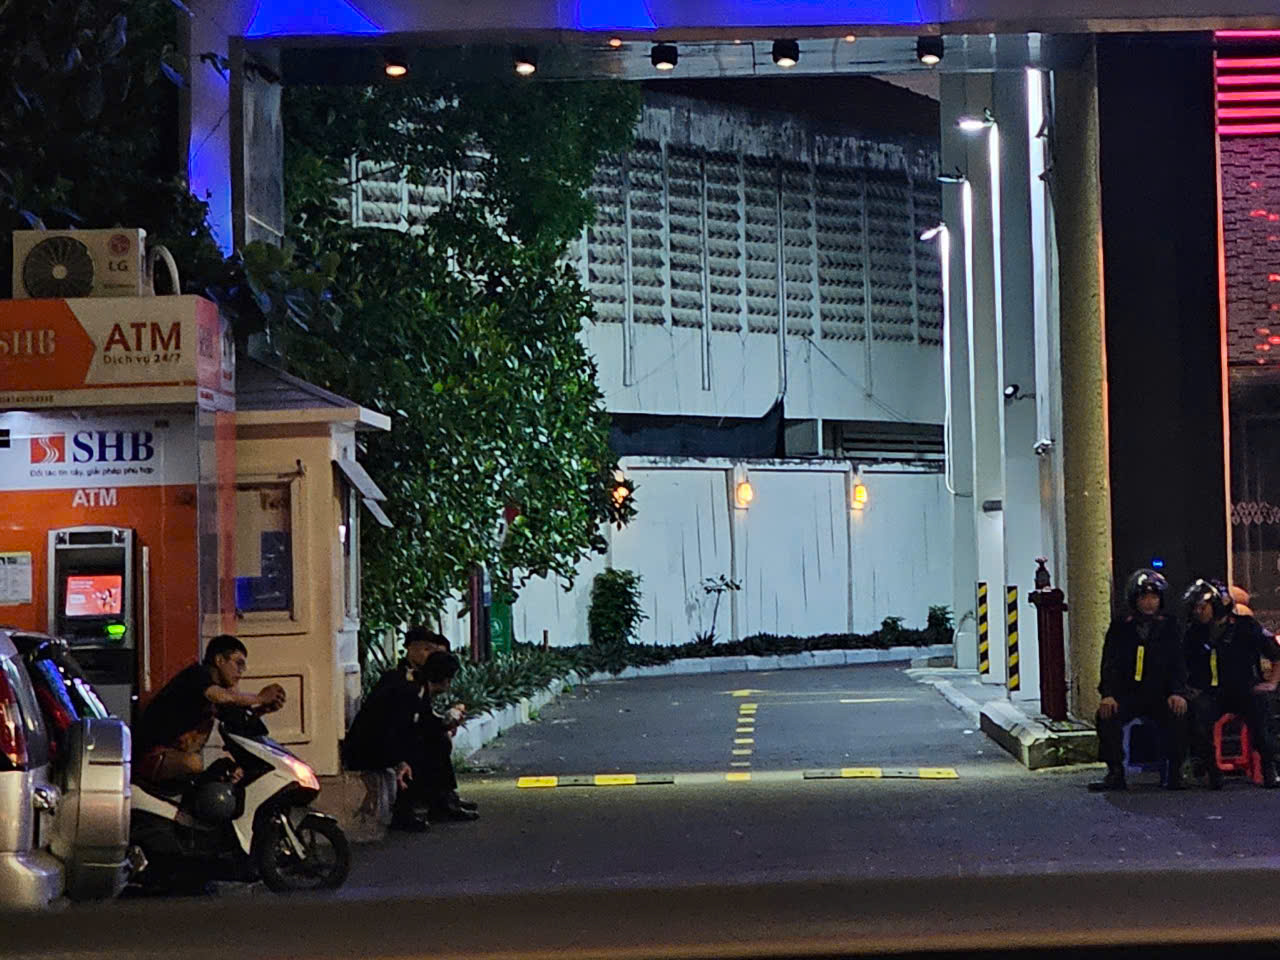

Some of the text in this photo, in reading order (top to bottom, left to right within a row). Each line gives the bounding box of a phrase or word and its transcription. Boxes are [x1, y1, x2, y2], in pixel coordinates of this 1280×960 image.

[109, 260, 129, 272] LG
[104, 321, 182, 352] ATM
[72, 430, 154, 463] SHB
[72, 488, 118, 507] ATM
